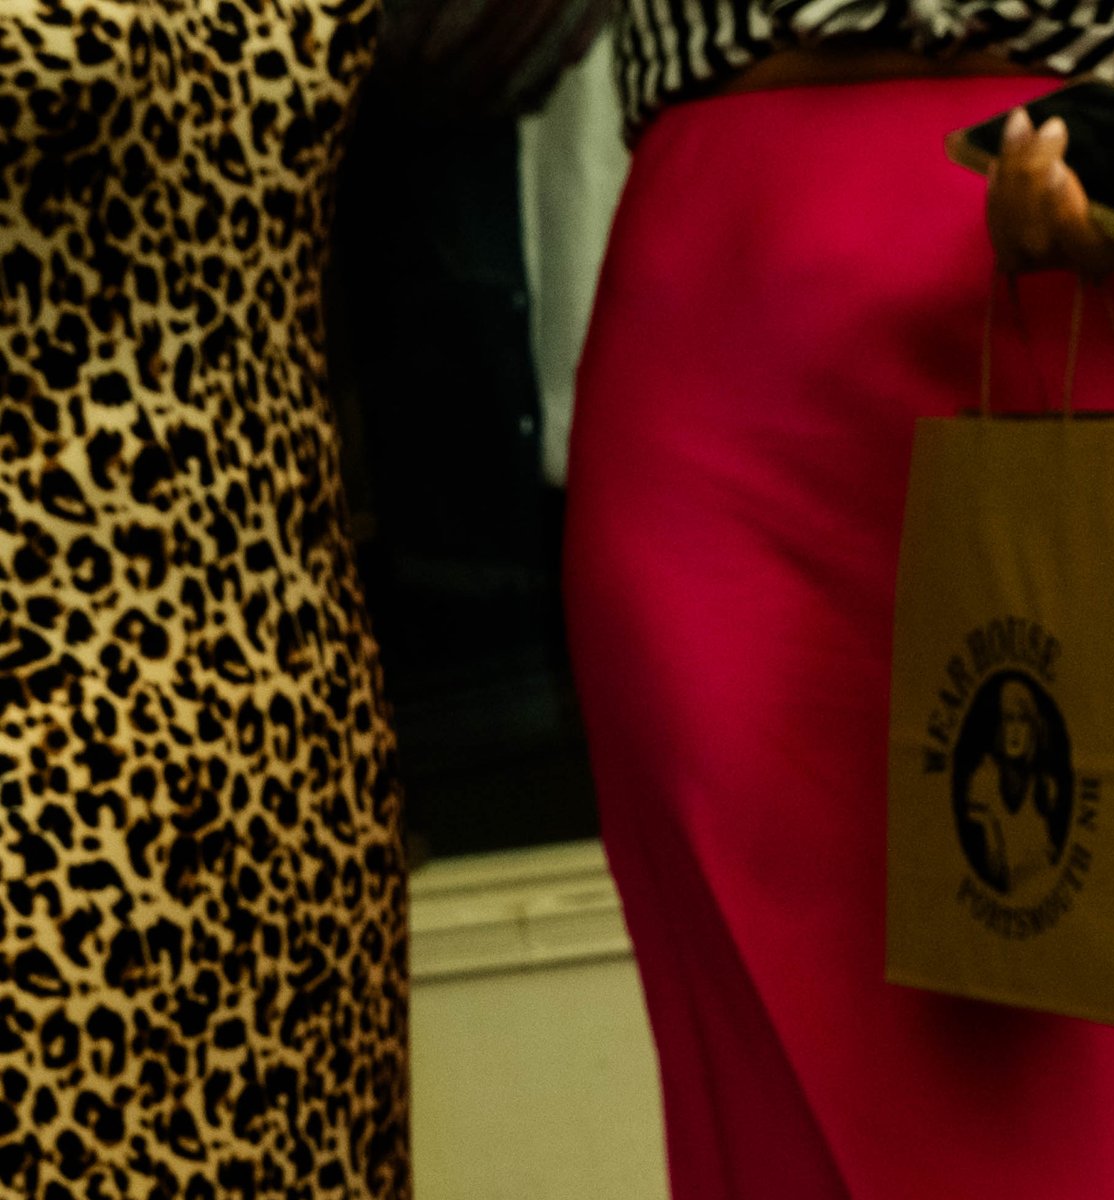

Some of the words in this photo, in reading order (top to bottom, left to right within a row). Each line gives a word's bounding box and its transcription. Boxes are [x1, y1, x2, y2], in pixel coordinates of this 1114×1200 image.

[923, 655, 973, 774] WEAR
[965, 615, 1062, 682] HOUSE
[1077, 776, 1102, 832] NH
